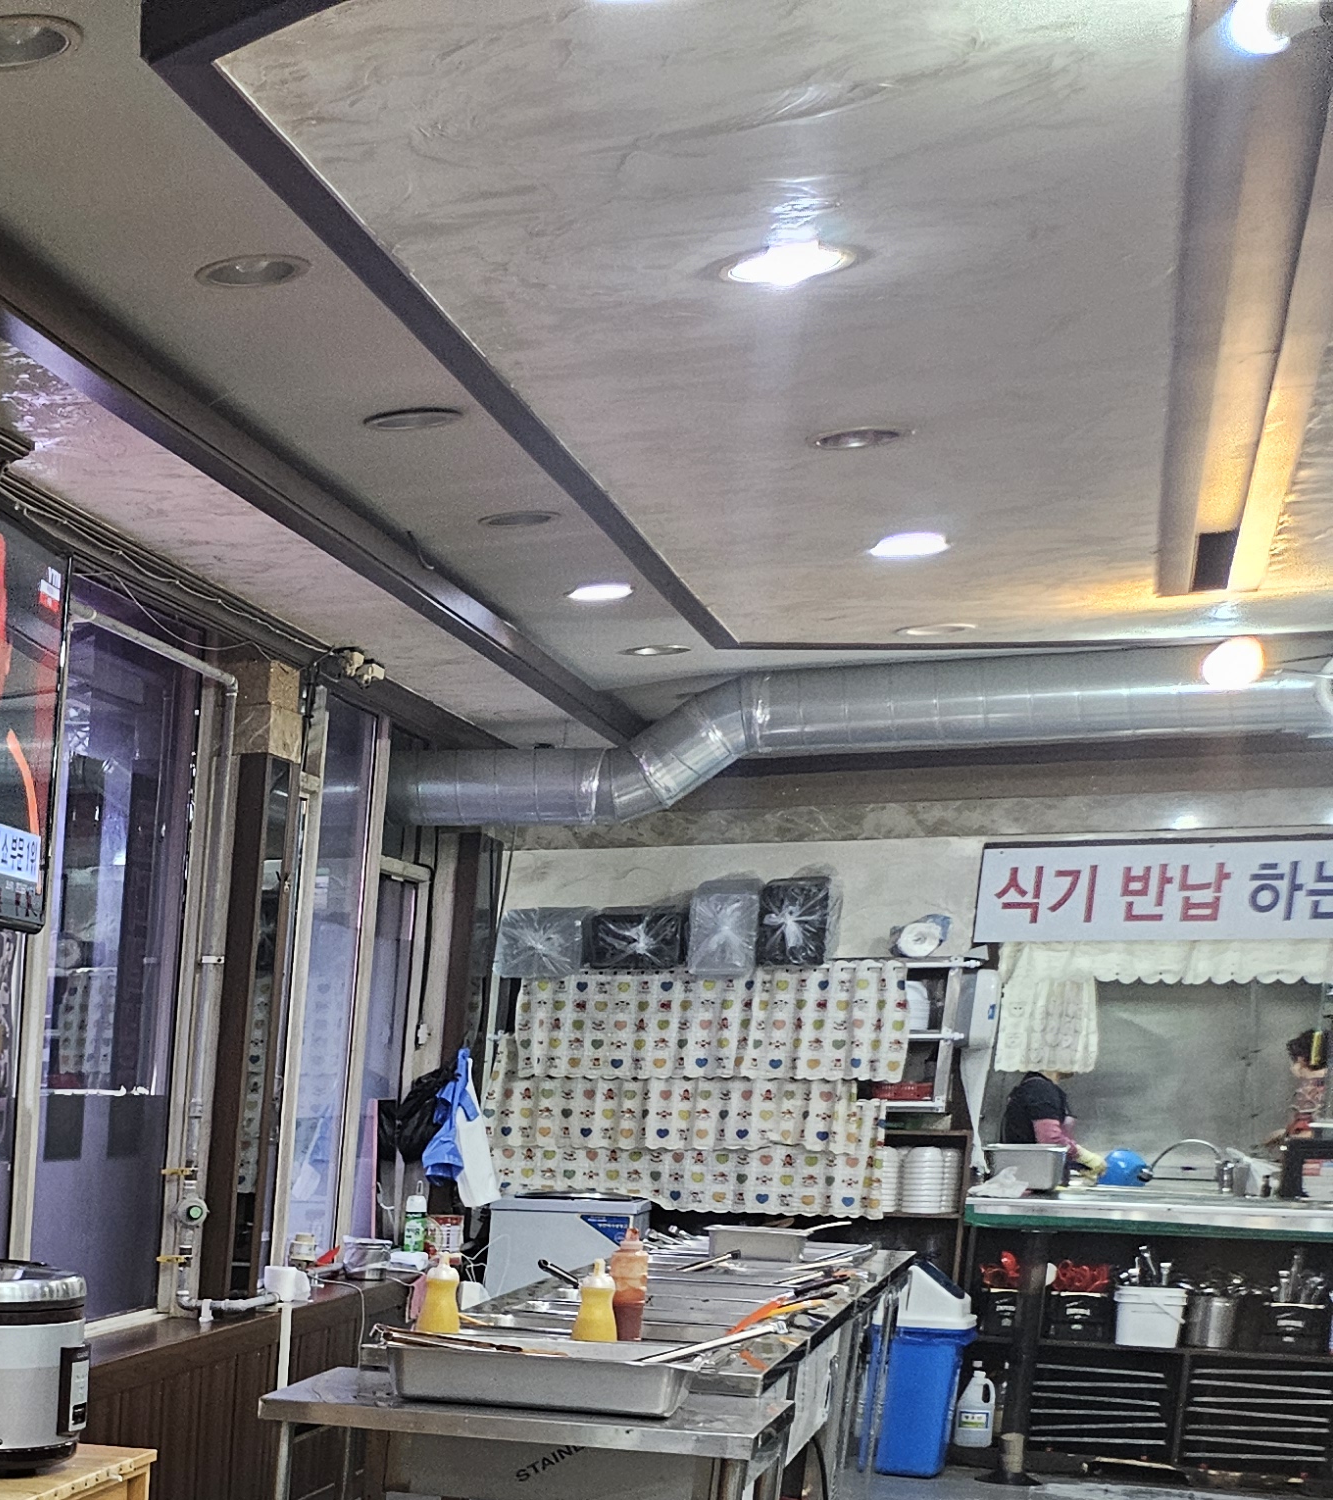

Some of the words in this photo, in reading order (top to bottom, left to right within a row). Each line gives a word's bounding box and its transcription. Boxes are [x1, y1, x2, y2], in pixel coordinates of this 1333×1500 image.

[10, 837, 24, 871] 부문
[994, 865, 1098, 923] 식기
[1120, 862, 1232, 922] 반납
